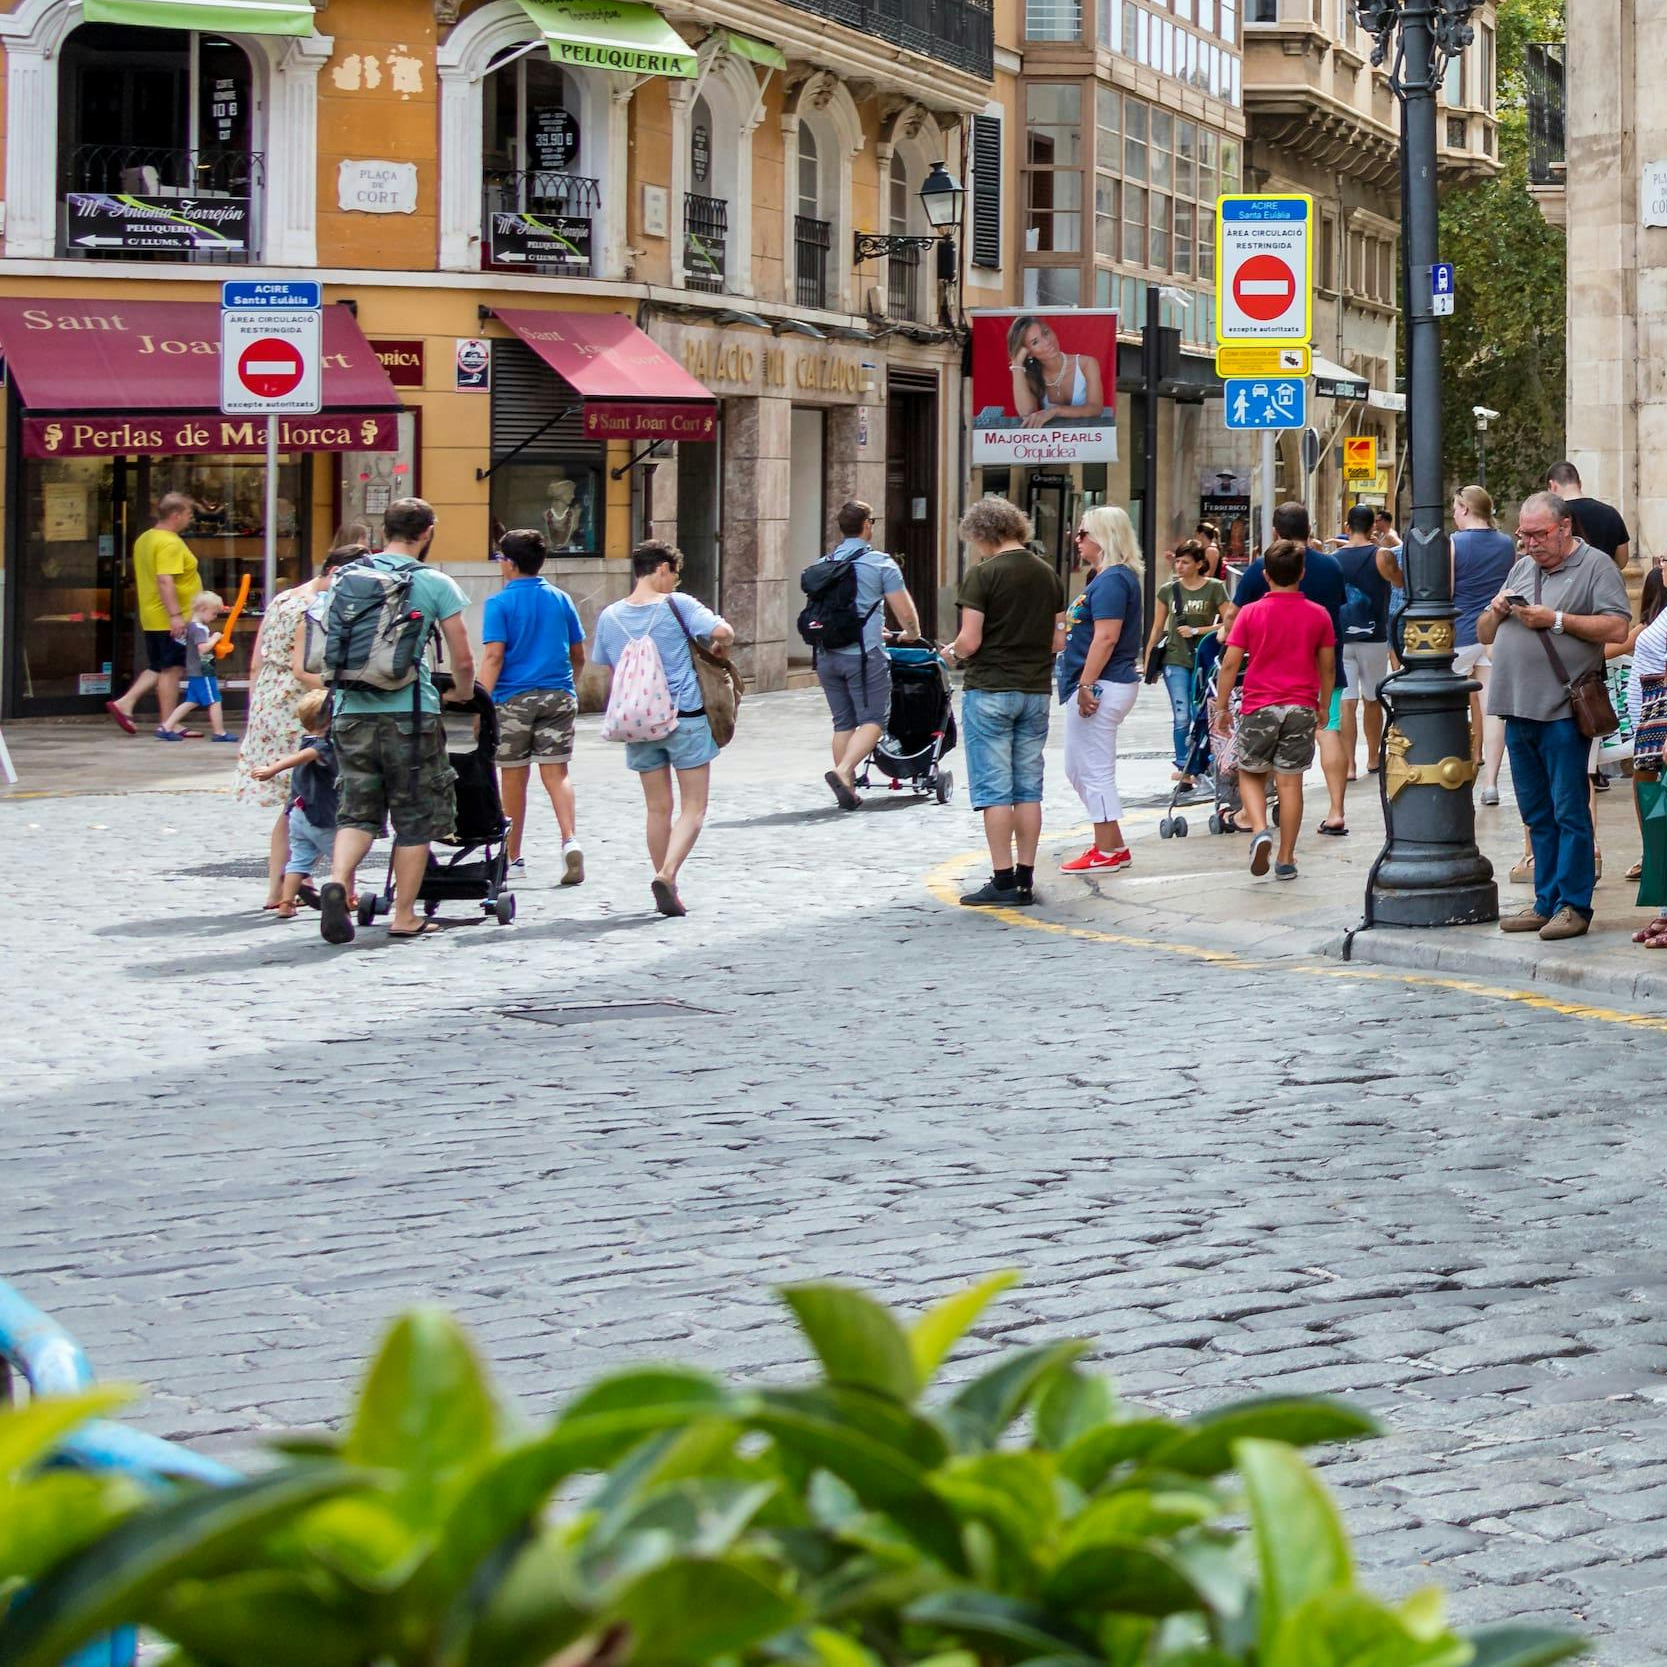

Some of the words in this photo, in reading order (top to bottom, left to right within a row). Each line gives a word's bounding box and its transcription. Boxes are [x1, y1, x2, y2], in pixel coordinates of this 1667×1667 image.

[560, 44, 683, 73] PELUQUERIA
[360, 169, 397, 182] PLAÇA
[357, 191, 399, 203] CORT
[1251, 202, 1278, 210] ACIRE
[109, 202, 173, 219] Antonia
[180, 199, 245, 226] Torrejón
[1239, 211, 1262, 219] Santa
[126, 224, 198, 234] PELUQUERIA
[1227, 228, 1249, 236] ÀREA
[1251, 228, 1302, 237] CIRCULACIÓ
[254, 285, 289, 293] ACIRE
[233, 296, 267, 304] Santa
[23, 310, 128, 331] Sant
[258, 315, 314, 323] CIRCULACIÓ
[519, 326, 565, 342] Sant
[227, 401, 263, 409] excepte
[600, 414, 630, 430] Sant
[635, 415, 667, 430] Joan
[672, 415, 700, 431] Cort
[72, 424, 164, 447] Perlas
[175, 422, 209, 447] de
[221, 421, 353, 447] Malorca
[985, 432, 1048, 444] MAJORCA
[1052, 431, 1103, 443] PEARLS
